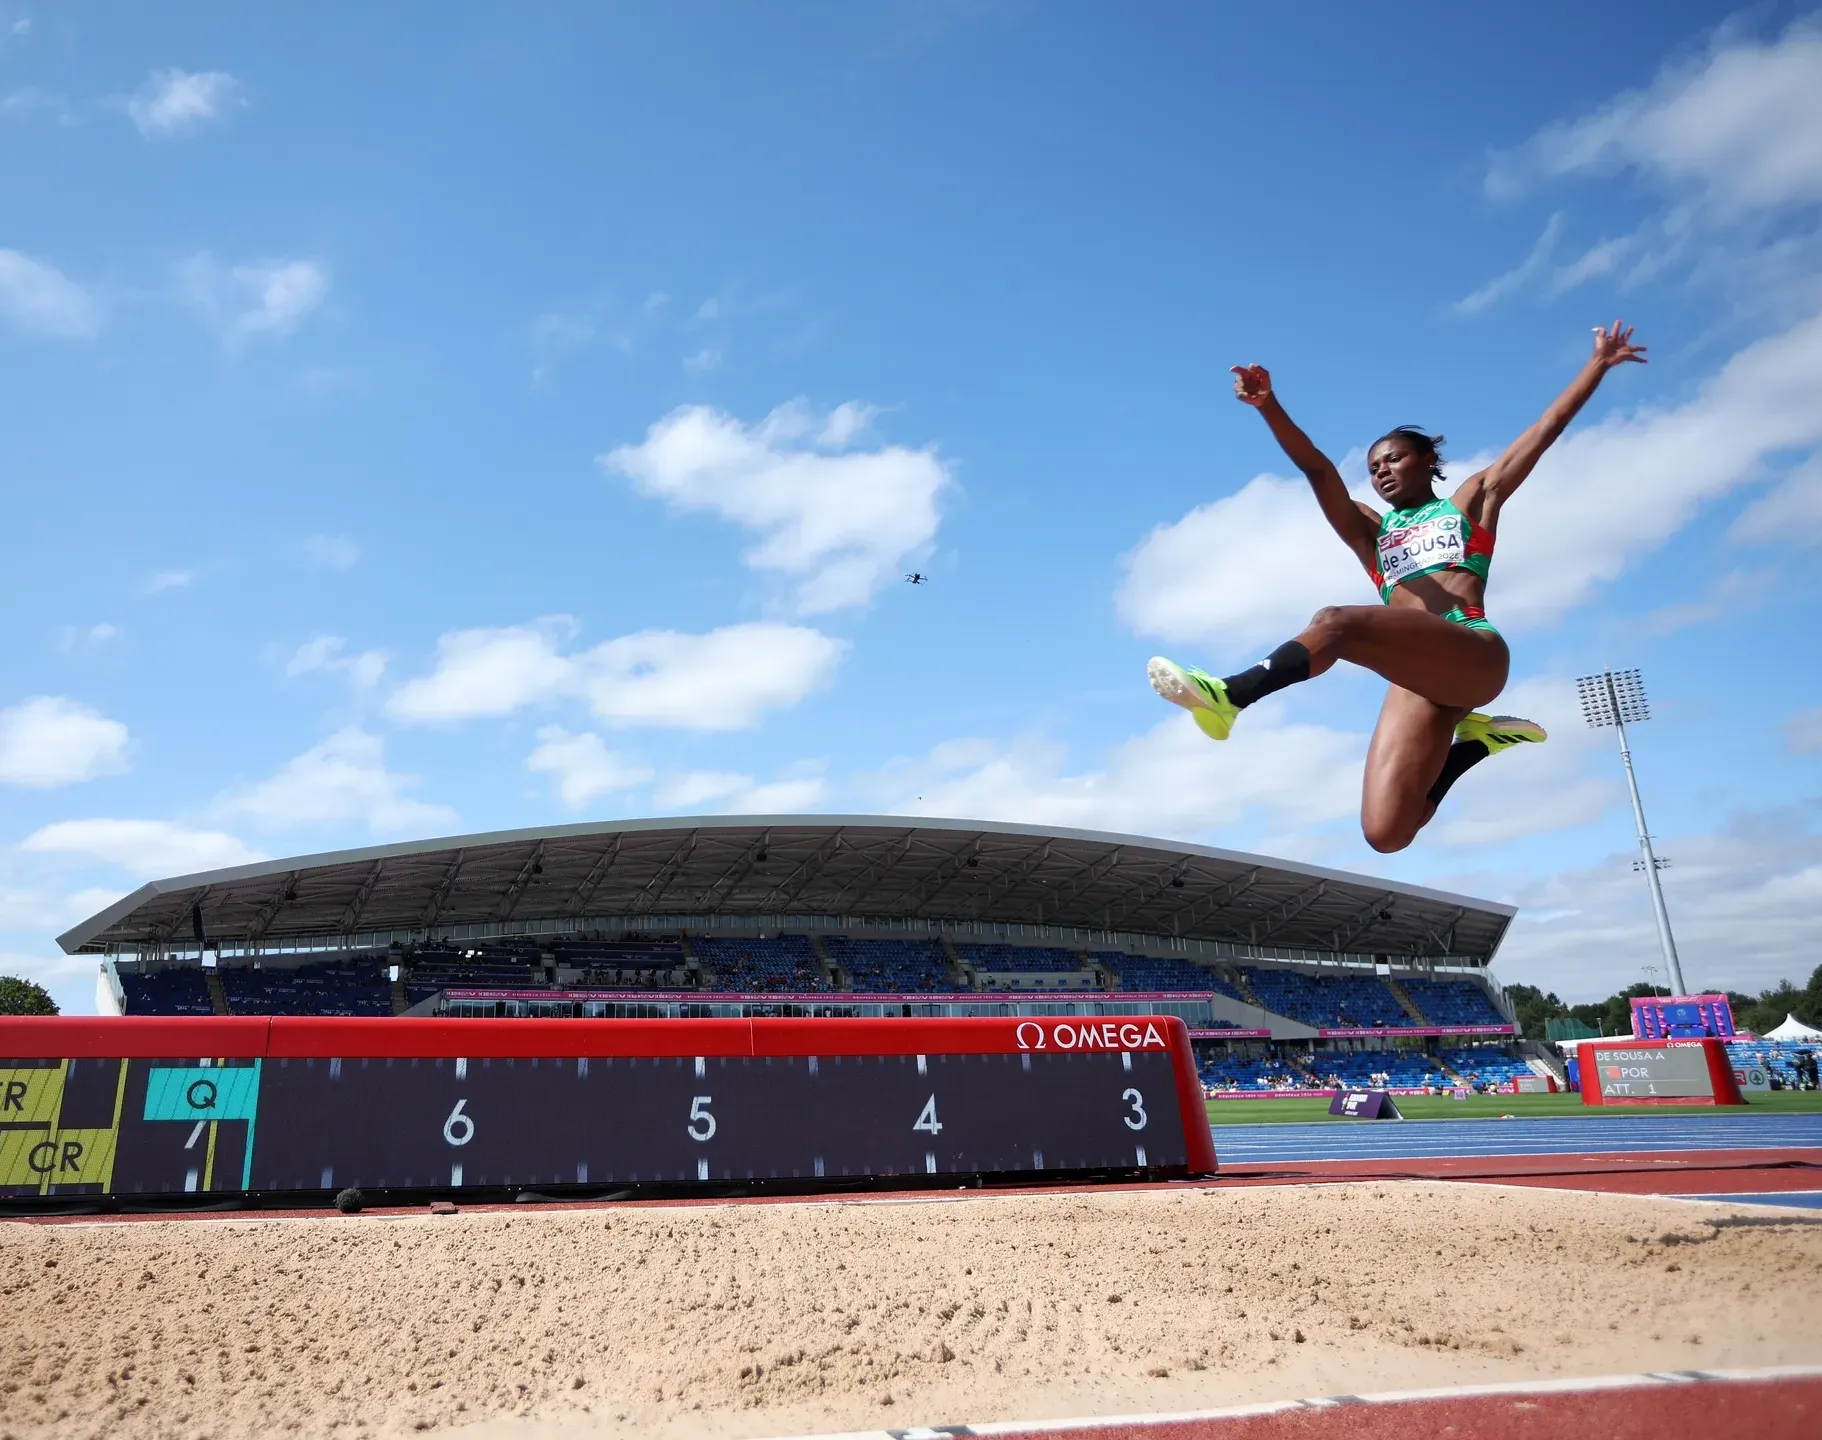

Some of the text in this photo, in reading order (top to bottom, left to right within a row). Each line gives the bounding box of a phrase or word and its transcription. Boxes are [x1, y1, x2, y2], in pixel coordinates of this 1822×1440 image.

[1382, 534, 1460, 572] de SOUSA
[1053, 1022, 1166, 1049] OMEGA
[1595, 1051, 1665, 1061] DE SOUSA A
[1620, 1067, 1649, 1078] POR
[0, 1081, 28, 1111] R
[186, 1079, 217, 1110] Q
[1604, 1083, 1657, 1095] ATT. 1
[443, 1099, 475, 1146] 6
[687, 1096, 717, 1142] 5
[912, 1092, 943, 1135] 4
[1122, 1088, 1148, 1131] 3
[28, 1141, 83, 1173] CR
